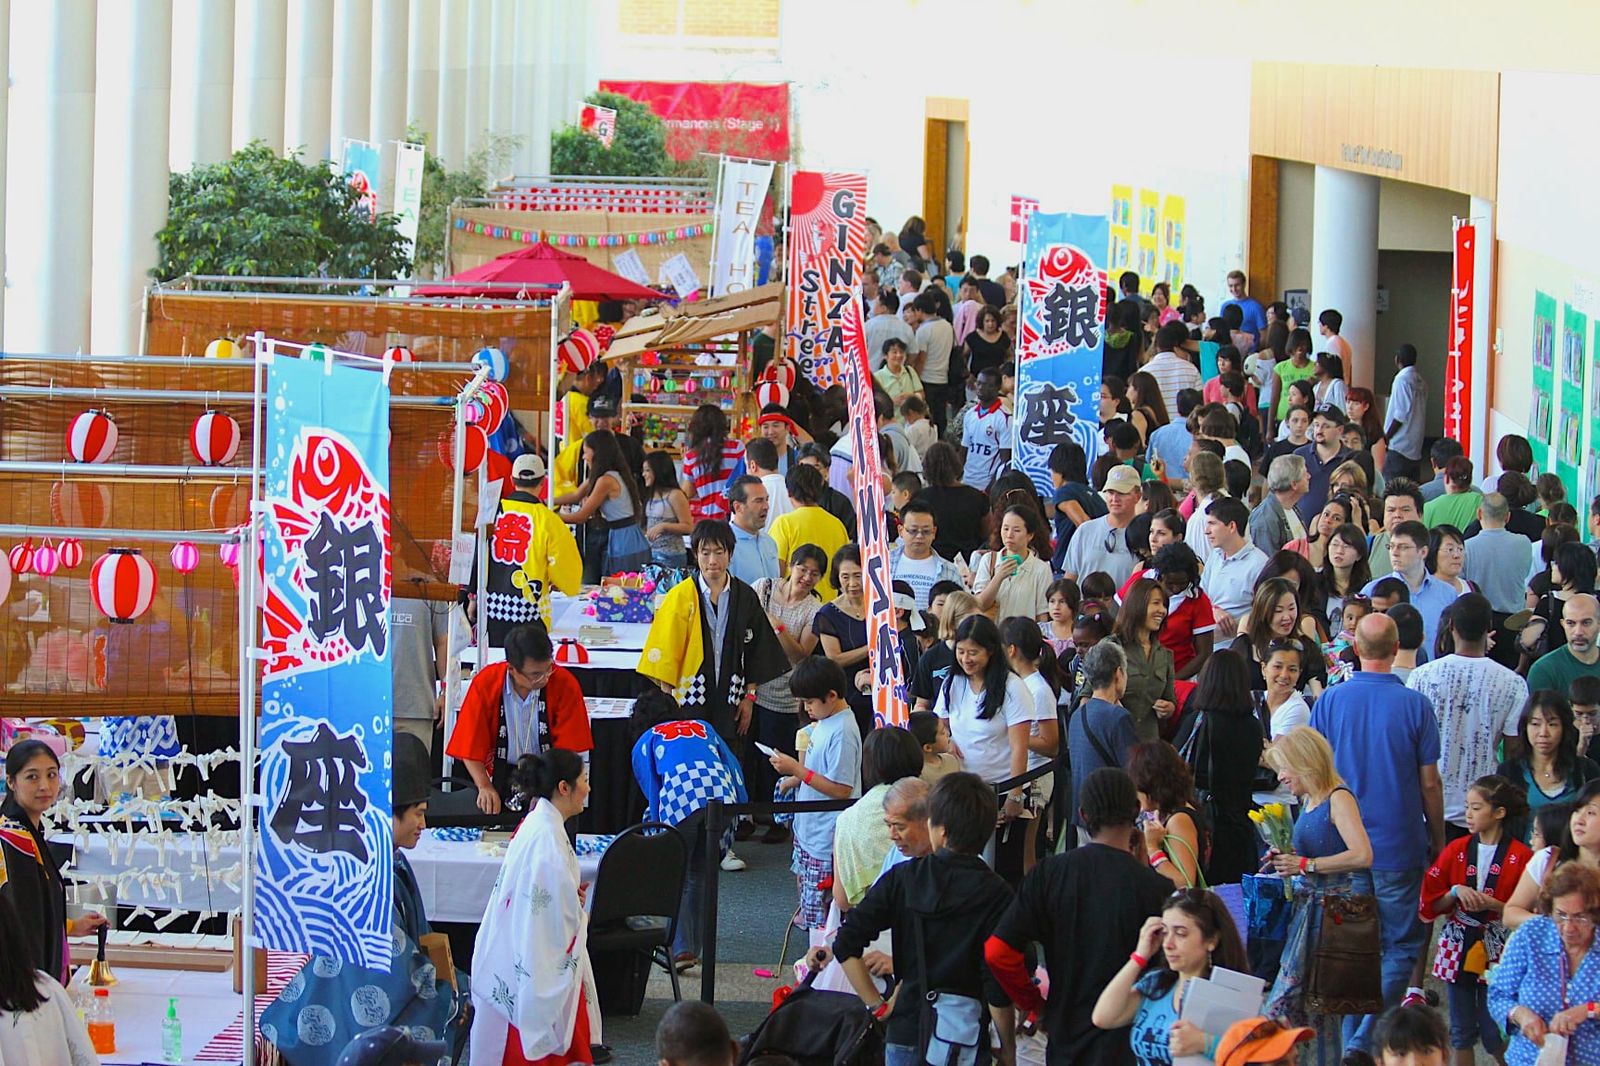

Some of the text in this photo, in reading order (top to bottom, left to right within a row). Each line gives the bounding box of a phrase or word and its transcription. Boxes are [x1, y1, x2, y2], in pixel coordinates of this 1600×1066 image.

[598, 121, 608, 136] G
[403, 167, 417, 222] TEA
[726, 181, 759, 294] TEA HO
[799, 269, 820, 374] Stree
[825, 189, 857, 353] GINZA
[1020, 282, 1100, 446] 銀座
[494, 512, 532, 564] 祭
[391, 610, 412, 623] tica
[269, 510, 388, 866] 銀座
